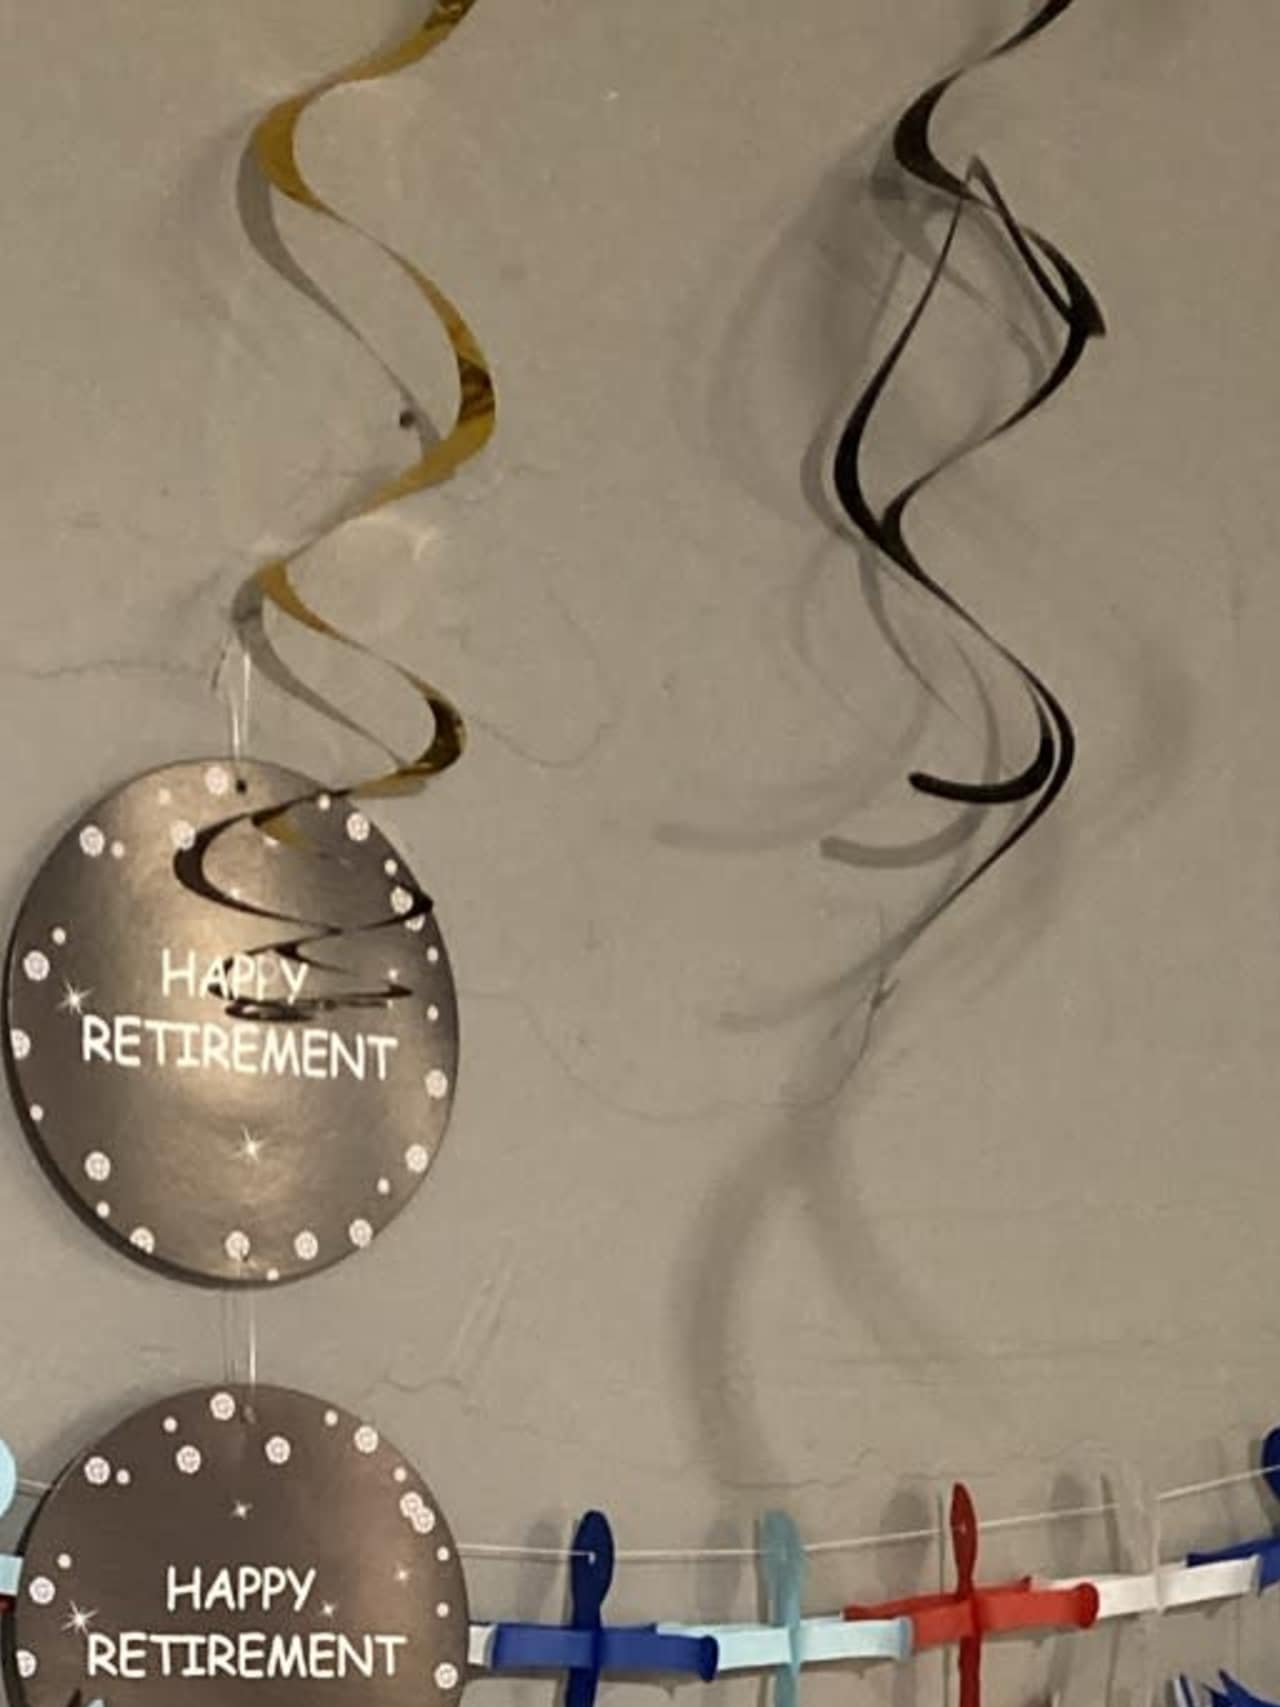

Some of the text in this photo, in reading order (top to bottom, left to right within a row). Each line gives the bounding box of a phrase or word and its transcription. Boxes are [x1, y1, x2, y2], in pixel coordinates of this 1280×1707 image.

[81, 1014, 399, 1081] RETIREMENT
[166, 1565, 317, 1612] HAPPY
[86, 1631, 408, 1679] RETIREMENT
